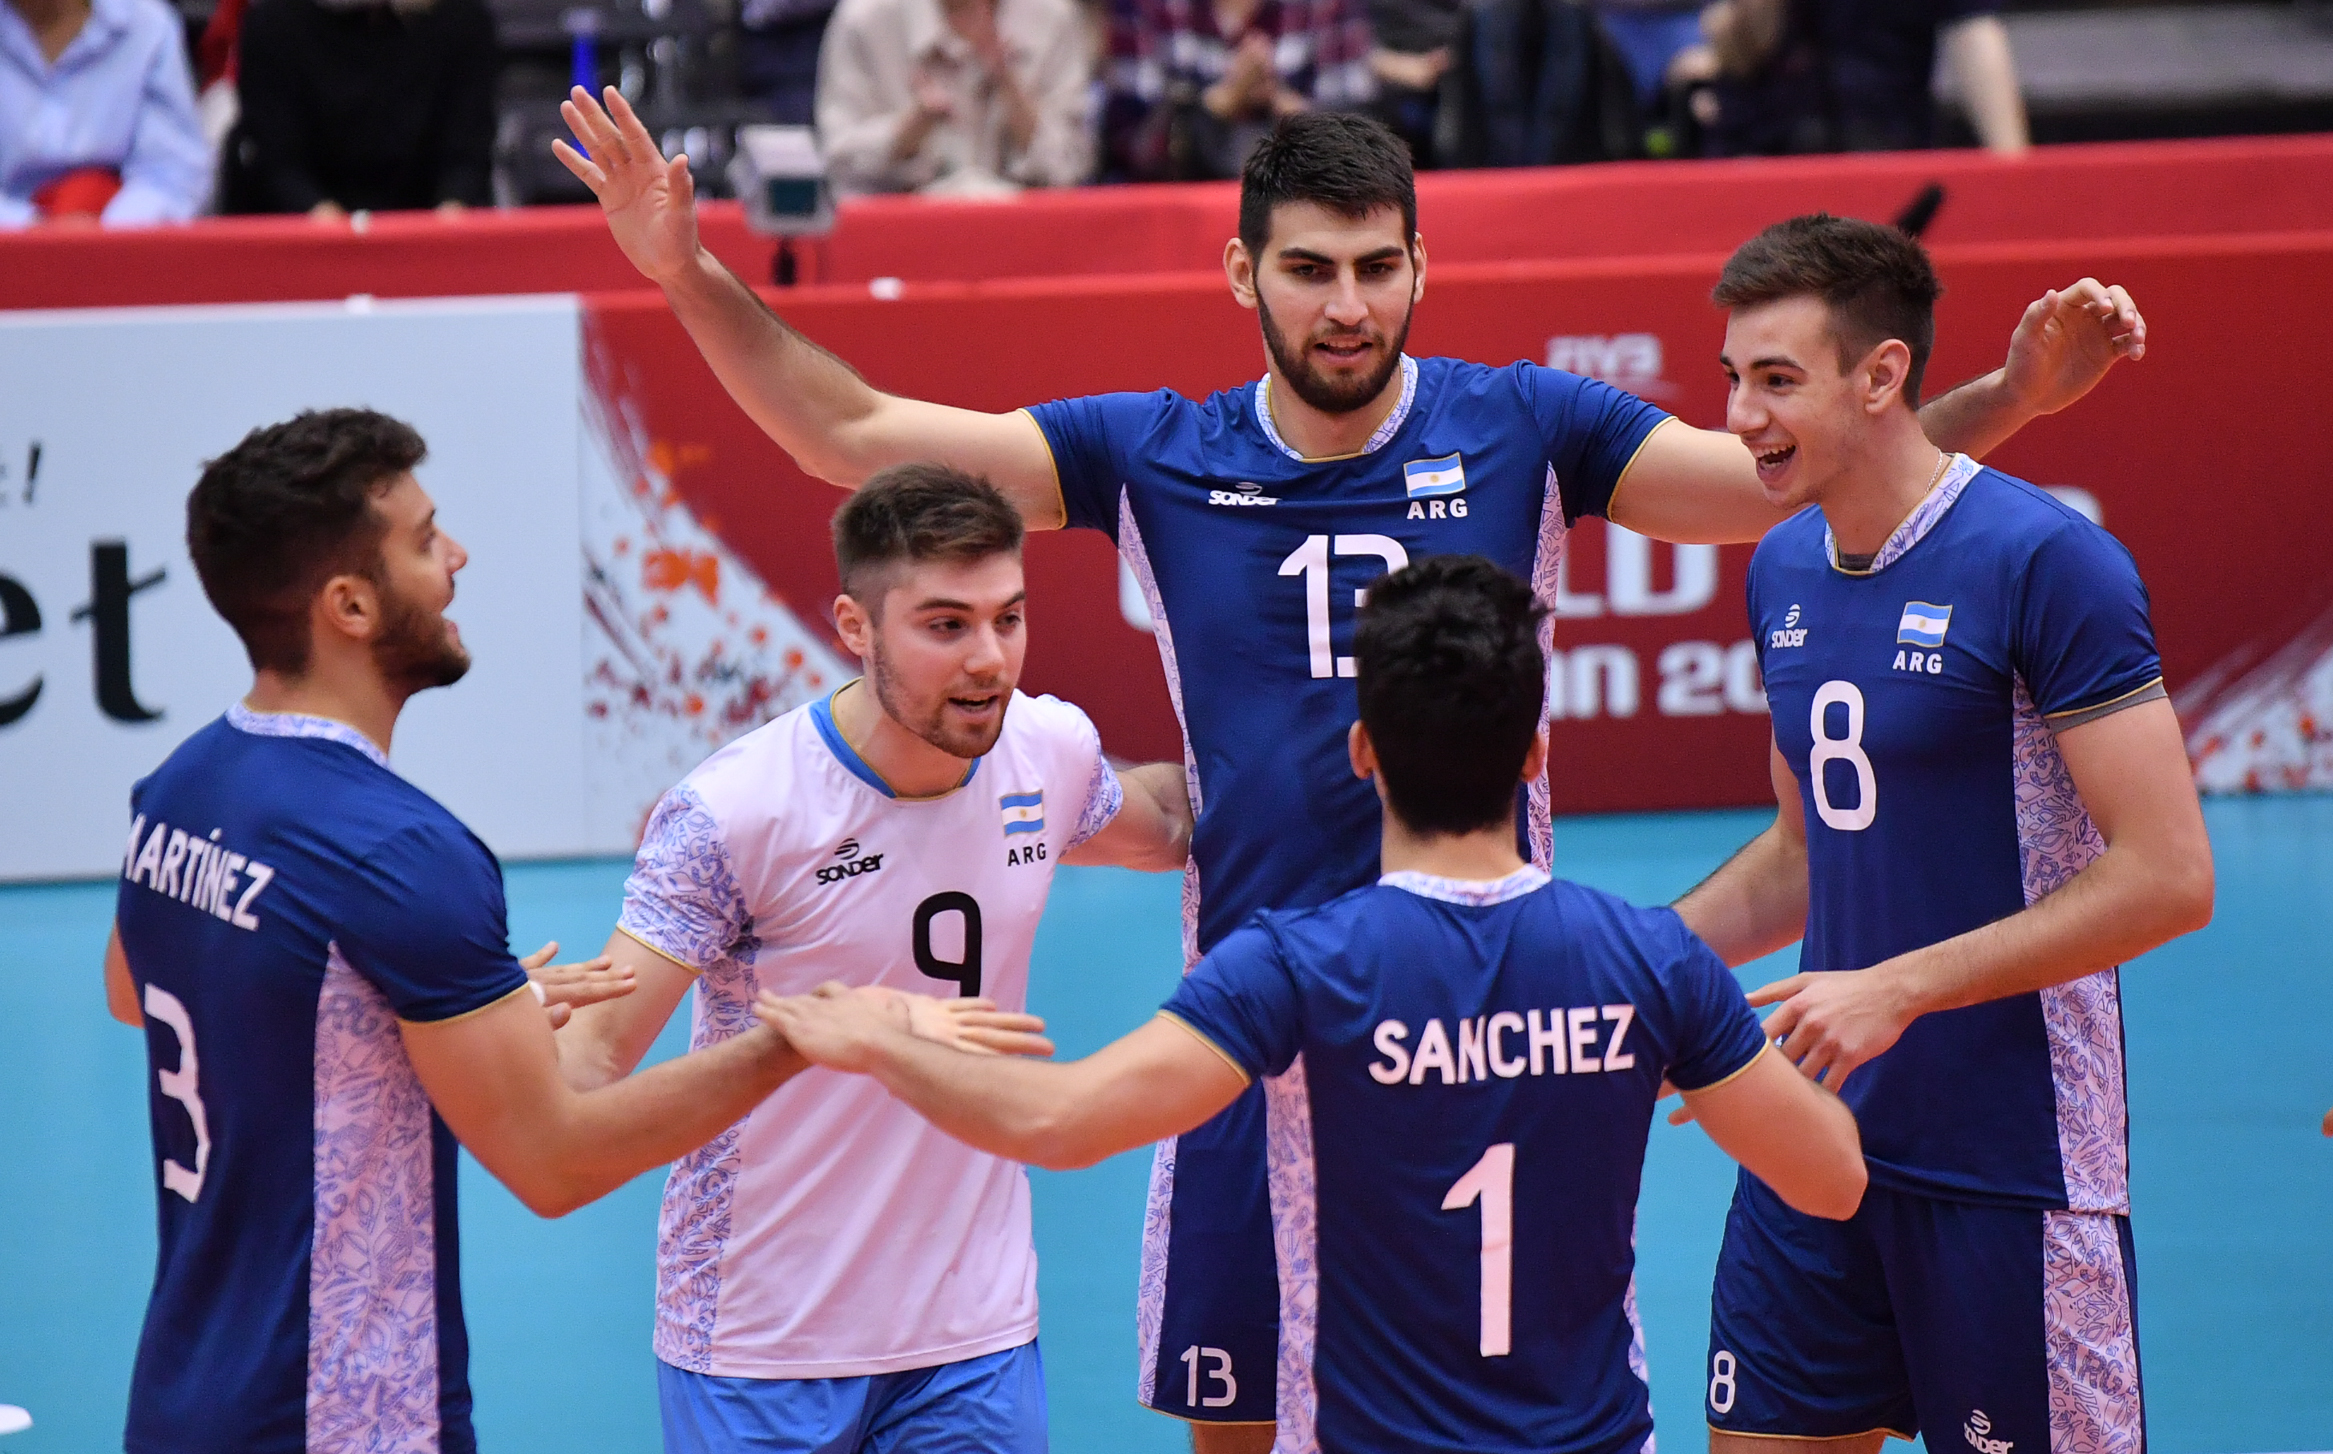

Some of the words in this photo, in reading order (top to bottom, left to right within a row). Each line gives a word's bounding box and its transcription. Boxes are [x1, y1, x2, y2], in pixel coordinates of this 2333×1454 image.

[1406, 498, 1469, 519] ARG
[1892, 650, 1943, 674] ARG
[1810, 680, 1877, 831] 8
[1007, 843, 1047, 867] ARG
[912, 891, 983, 998] 9
[1368, 1003, 1636, 1085] SANCHEZ
[144, 982, 211, 1203] 3
[1441, 1142, 1515, 1358] 1
[1180, 1344, 1237, 1408] 13
[1709, 1349, 1736, 1414] 8
